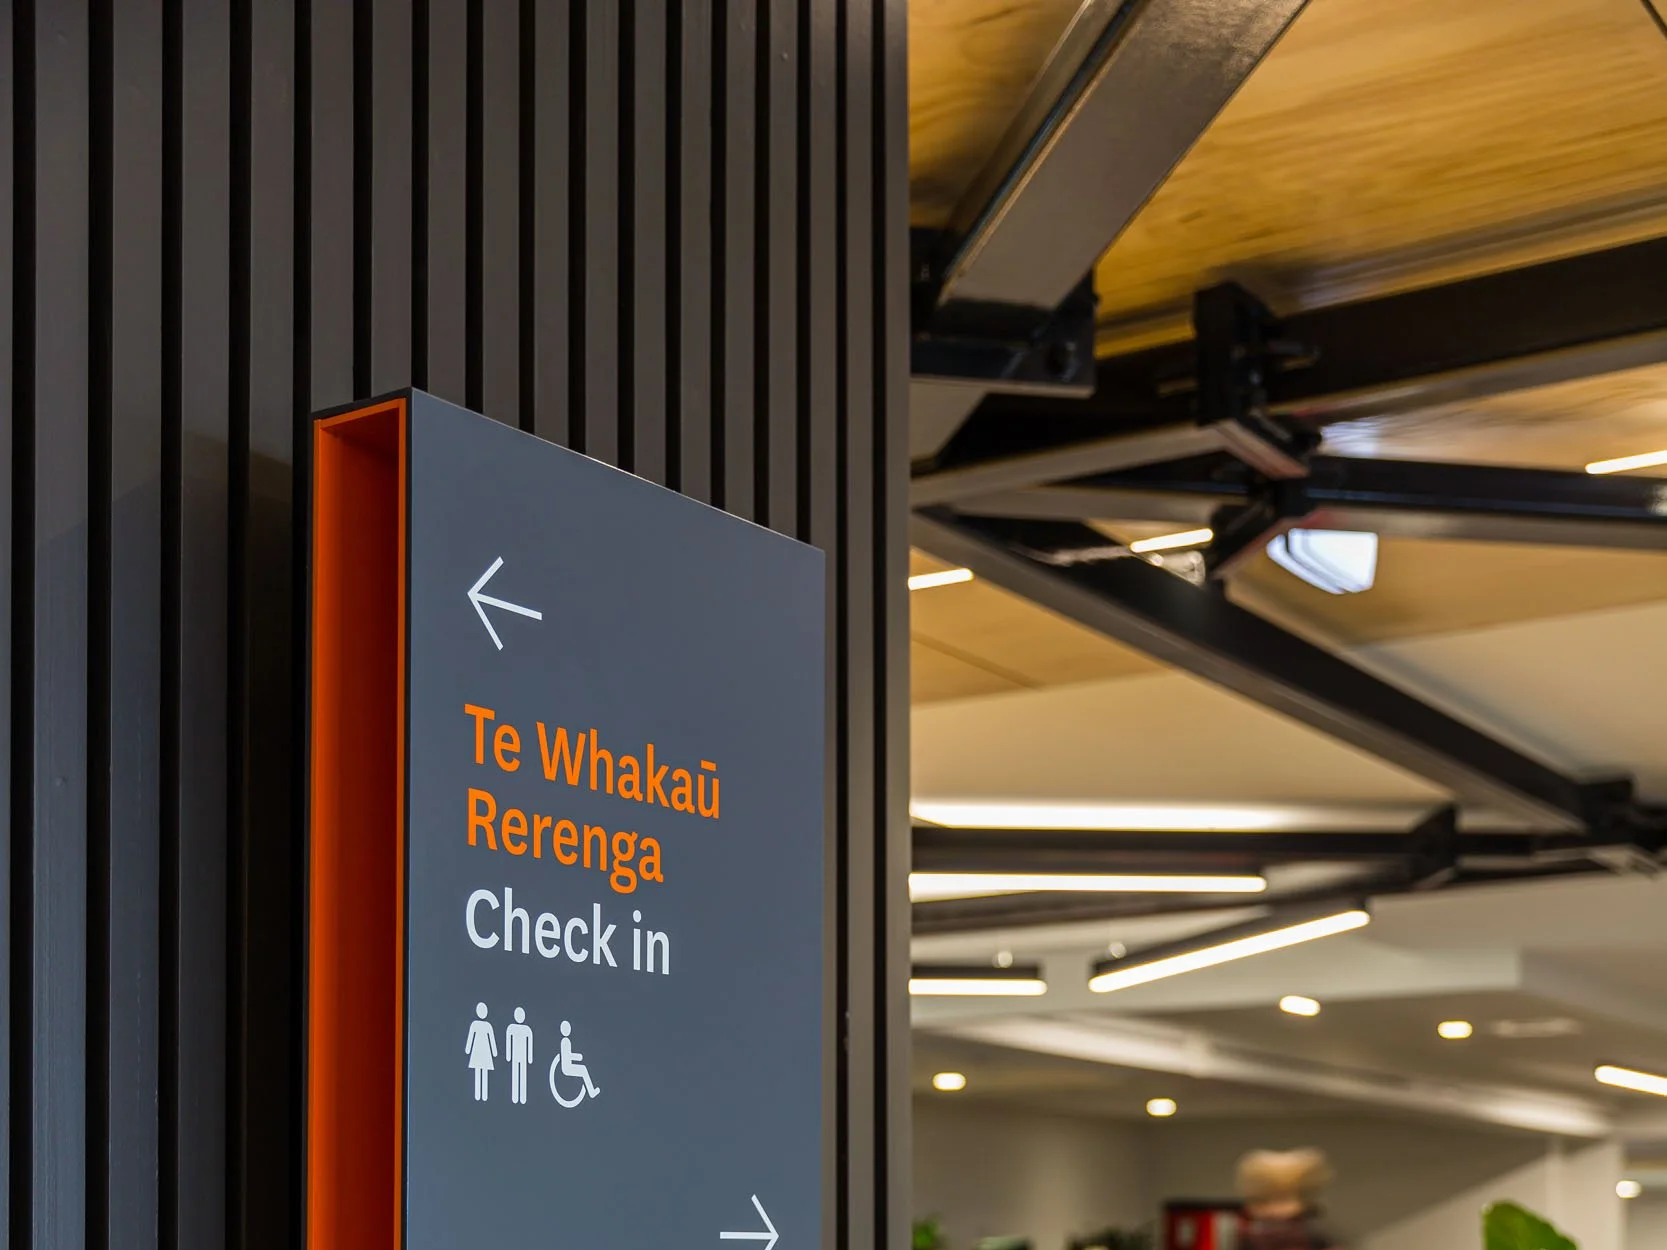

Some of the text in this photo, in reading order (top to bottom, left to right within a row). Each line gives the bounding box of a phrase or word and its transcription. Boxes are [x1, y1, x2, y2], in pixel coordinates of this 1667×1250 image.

[465, 704, 720, 819] Te Whakaū
[467, 787, 664, 894] Rerenga
[465, 886, 670, 975] Check in
